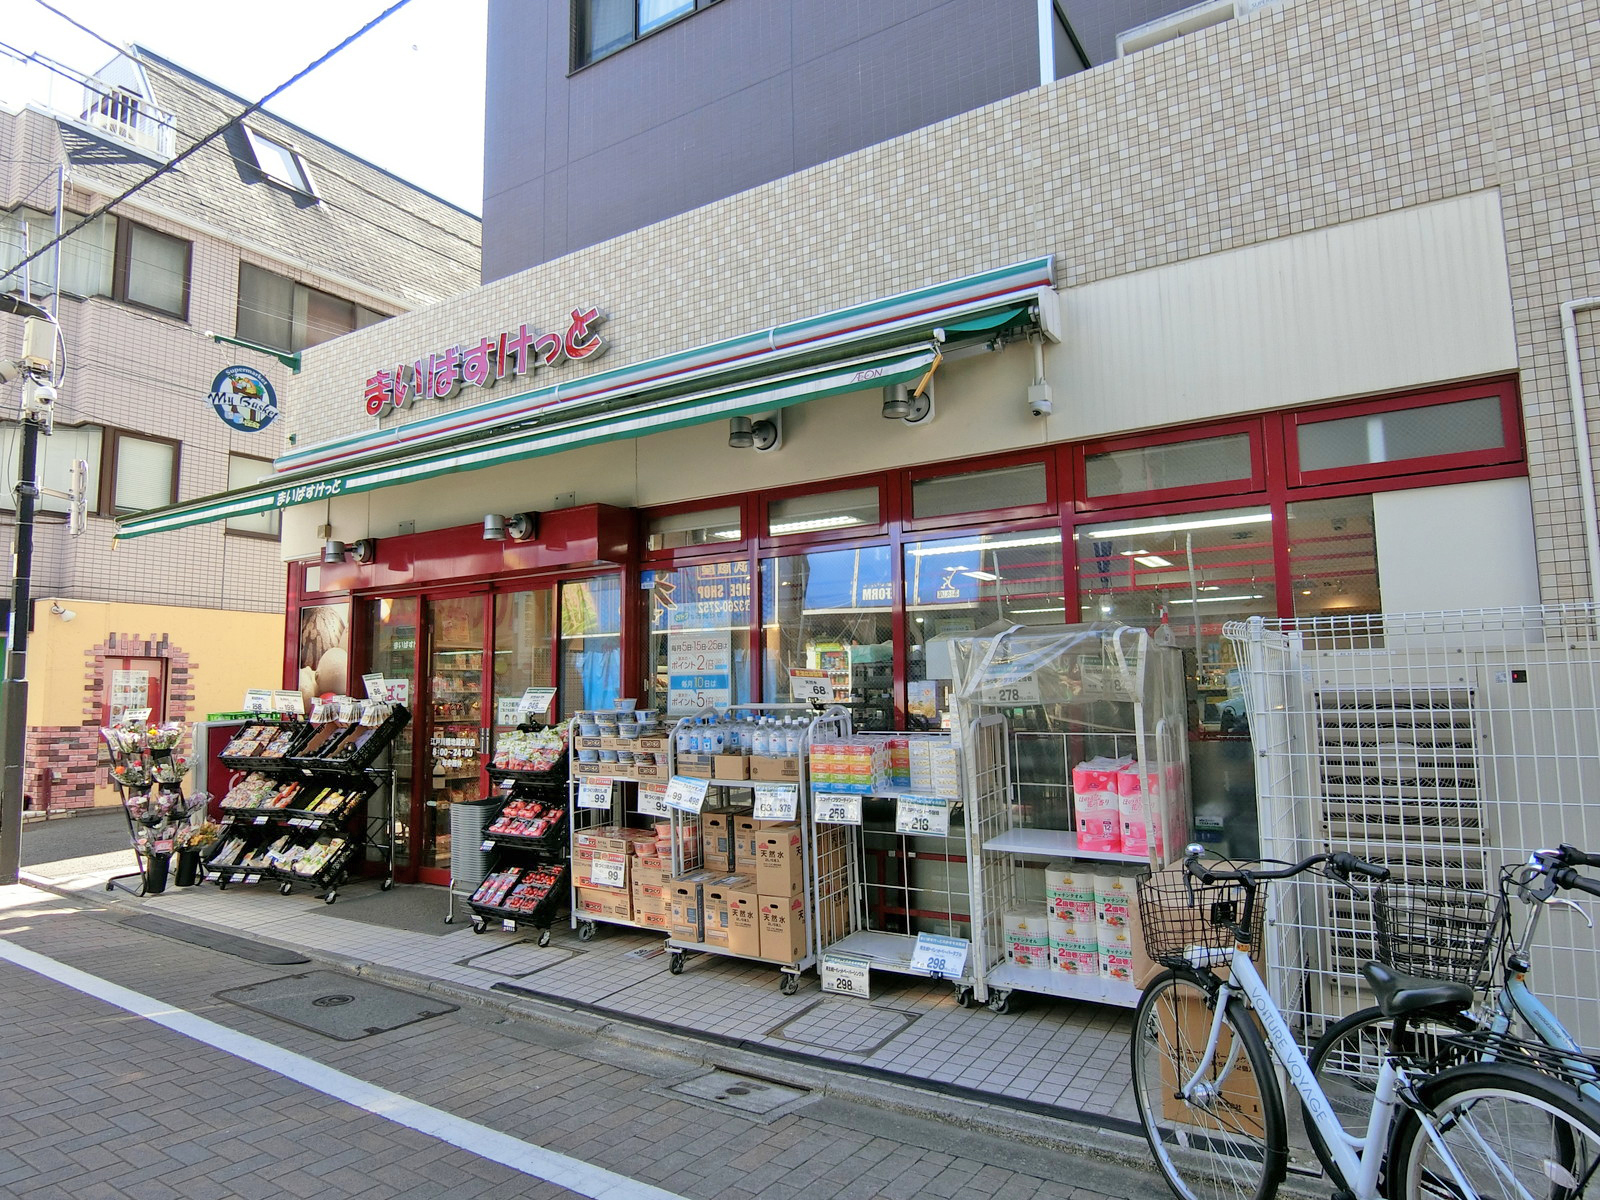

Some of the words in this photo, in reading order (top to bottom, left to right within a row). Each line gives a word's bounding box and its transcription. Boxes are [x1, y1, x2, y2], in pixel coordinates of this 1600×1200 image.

[364, 306, 603, 418] まいばすけっと
[225, 367, 268, 386] Supermarket
[207, 391, 234, 406] My
[239, 395, 279, 419] Basket
[277, 479, 342, 507] まいばすけっと
[813, 685, 826, 695] 68
[999, 689, 1019, 701] 278
[594, 794, 605, 803] 99
[672, 791, 682, 801] 99
[656, 801, 667, 811] 99
[828, 808, 845, 819] 258
[760, 850, 784, 858] 天然水
[607, 870, 618, 881] 99
[732, 908, 755, 919] 天然水
[763, 913, 786, 924] 天然水
[927, 957, 946, 970] 298
[836, 978, 853, 991] 298
[1252, 986, 1288, 1048] VOITURE
[1286, 1052, 1328, 1121] VOYAGE
